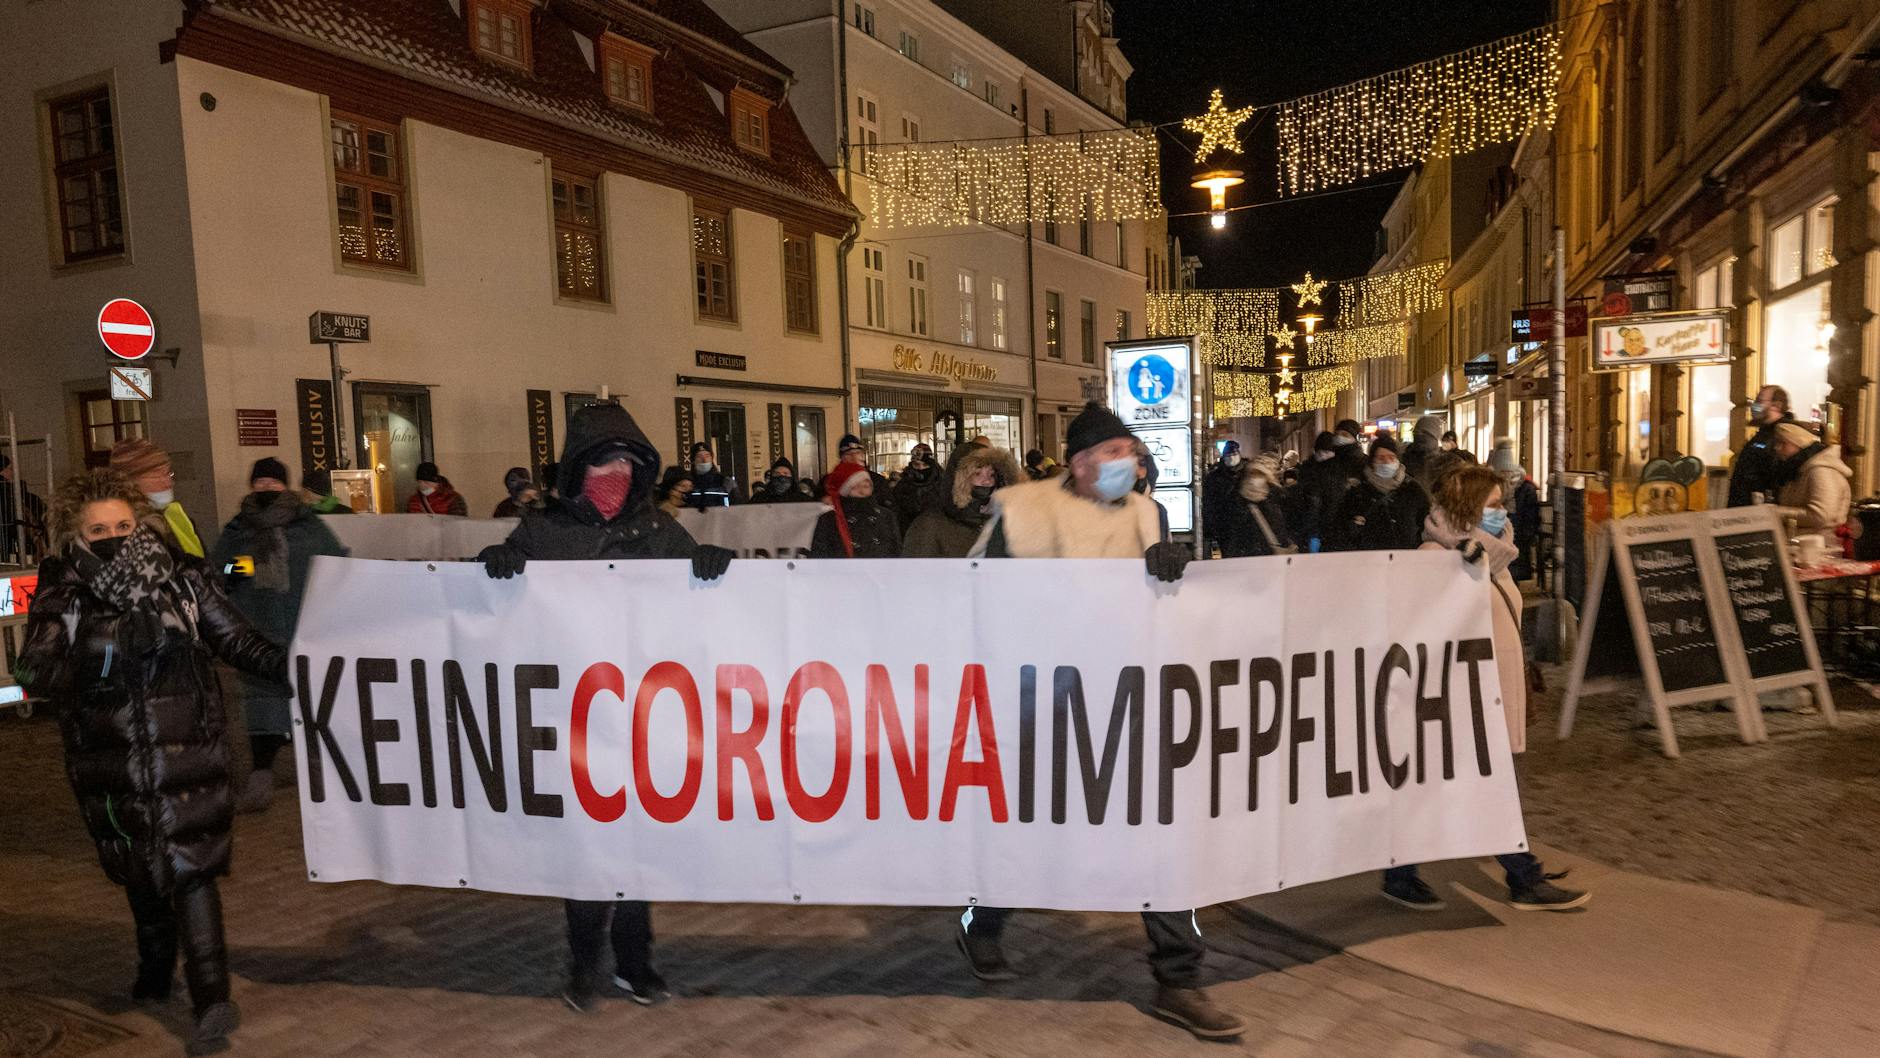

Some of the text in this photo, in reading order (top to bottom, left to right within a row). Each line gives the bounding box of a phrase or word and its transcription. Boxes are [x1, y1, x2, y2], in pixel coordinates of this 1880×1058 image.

[334, 315, 368, 329] KNUTS
[1512, 319, 1531, 329] HUS
[344, 327, 361, 338] BAR
[699, 353, 745, 368] MODE EXCLUSIV
[1134, 406, 1169, 421] ZONE
[308, 389, 326, 472] XCLUSIV
[535, 399, 548, 465] XCLUSIV
[769, 410, 781, 461] XCLUSIV
